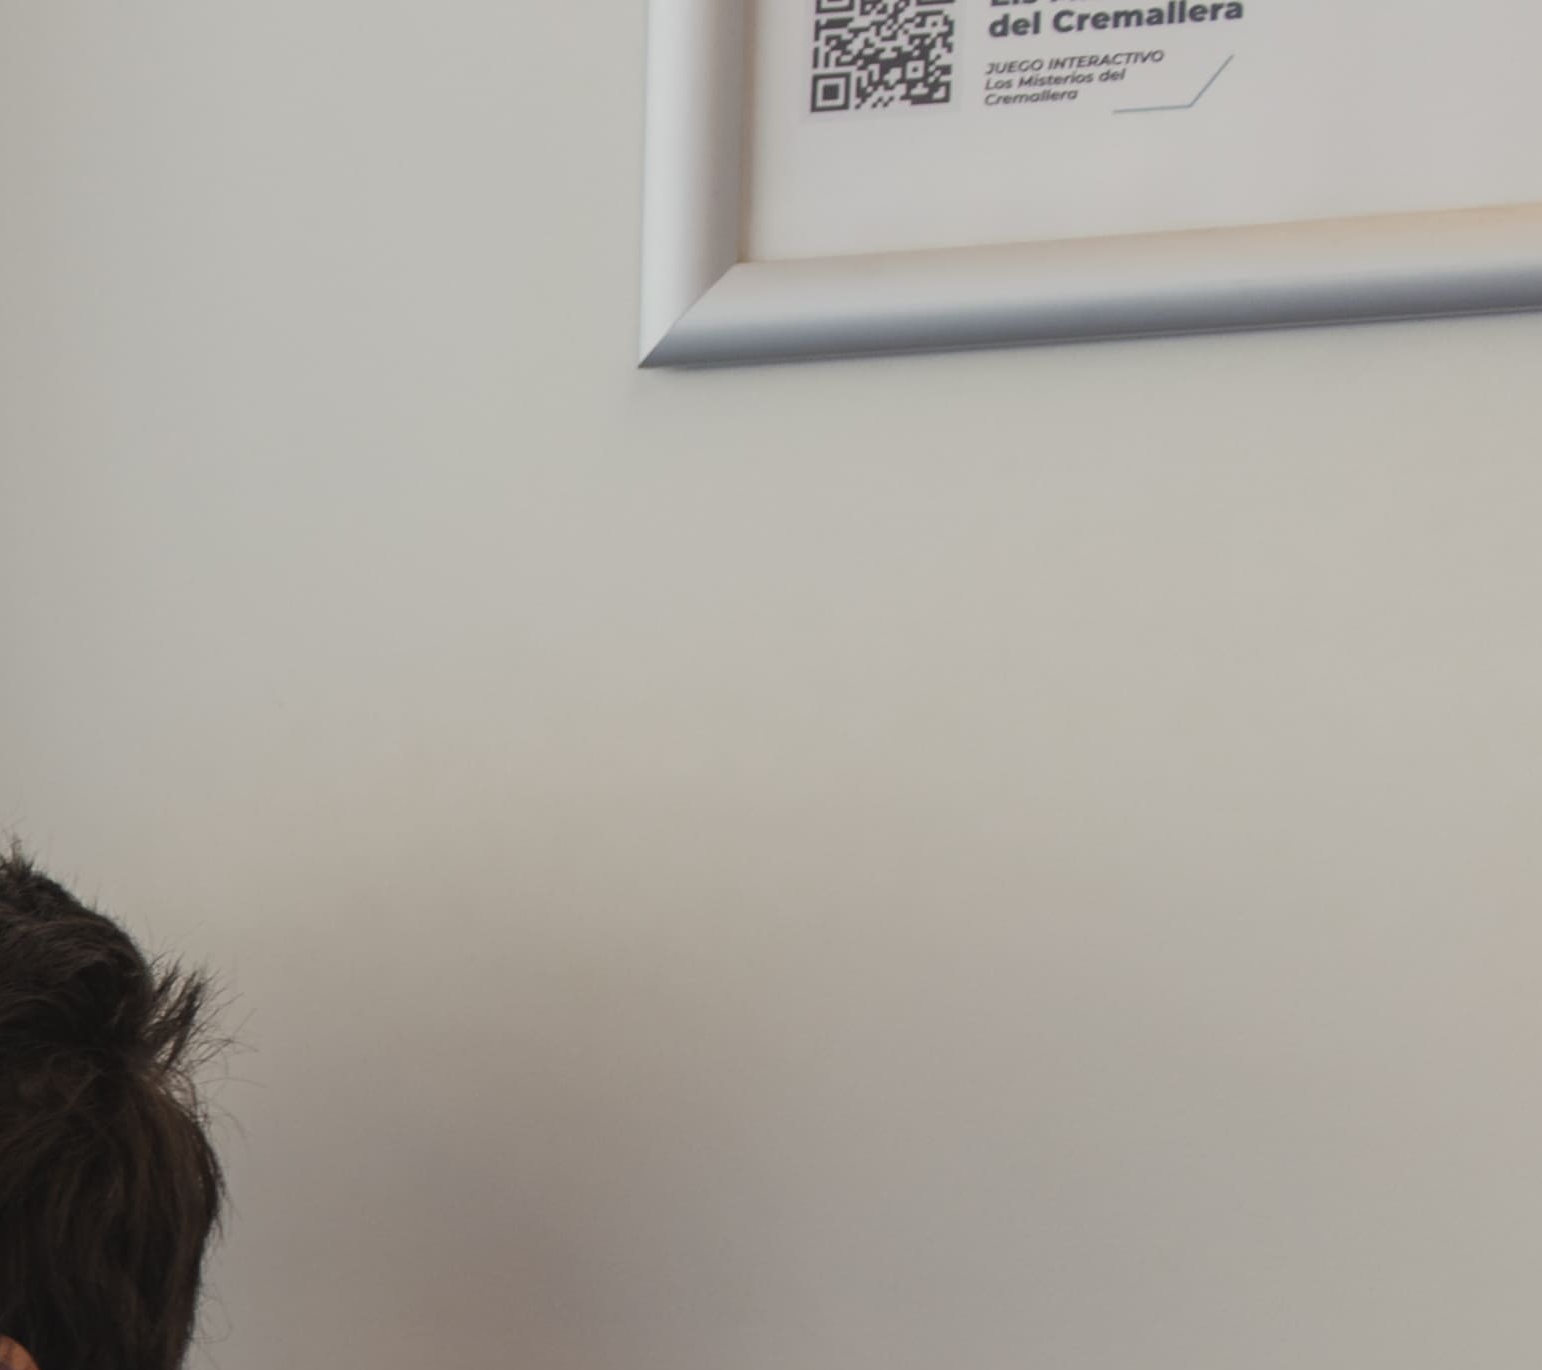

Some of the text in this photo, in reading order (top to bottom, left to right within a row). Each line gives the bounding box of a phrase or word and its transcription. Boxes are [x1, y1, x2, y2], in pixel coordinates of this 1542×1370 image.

[989, 0, 1244, 38] del Cremallera
[985, 50, 1165, 75] JUEGO INTERACTIVO
[984, 68, 1126, 91] Los Misterios del
[984, 88, 1078, 105] Cremallera
